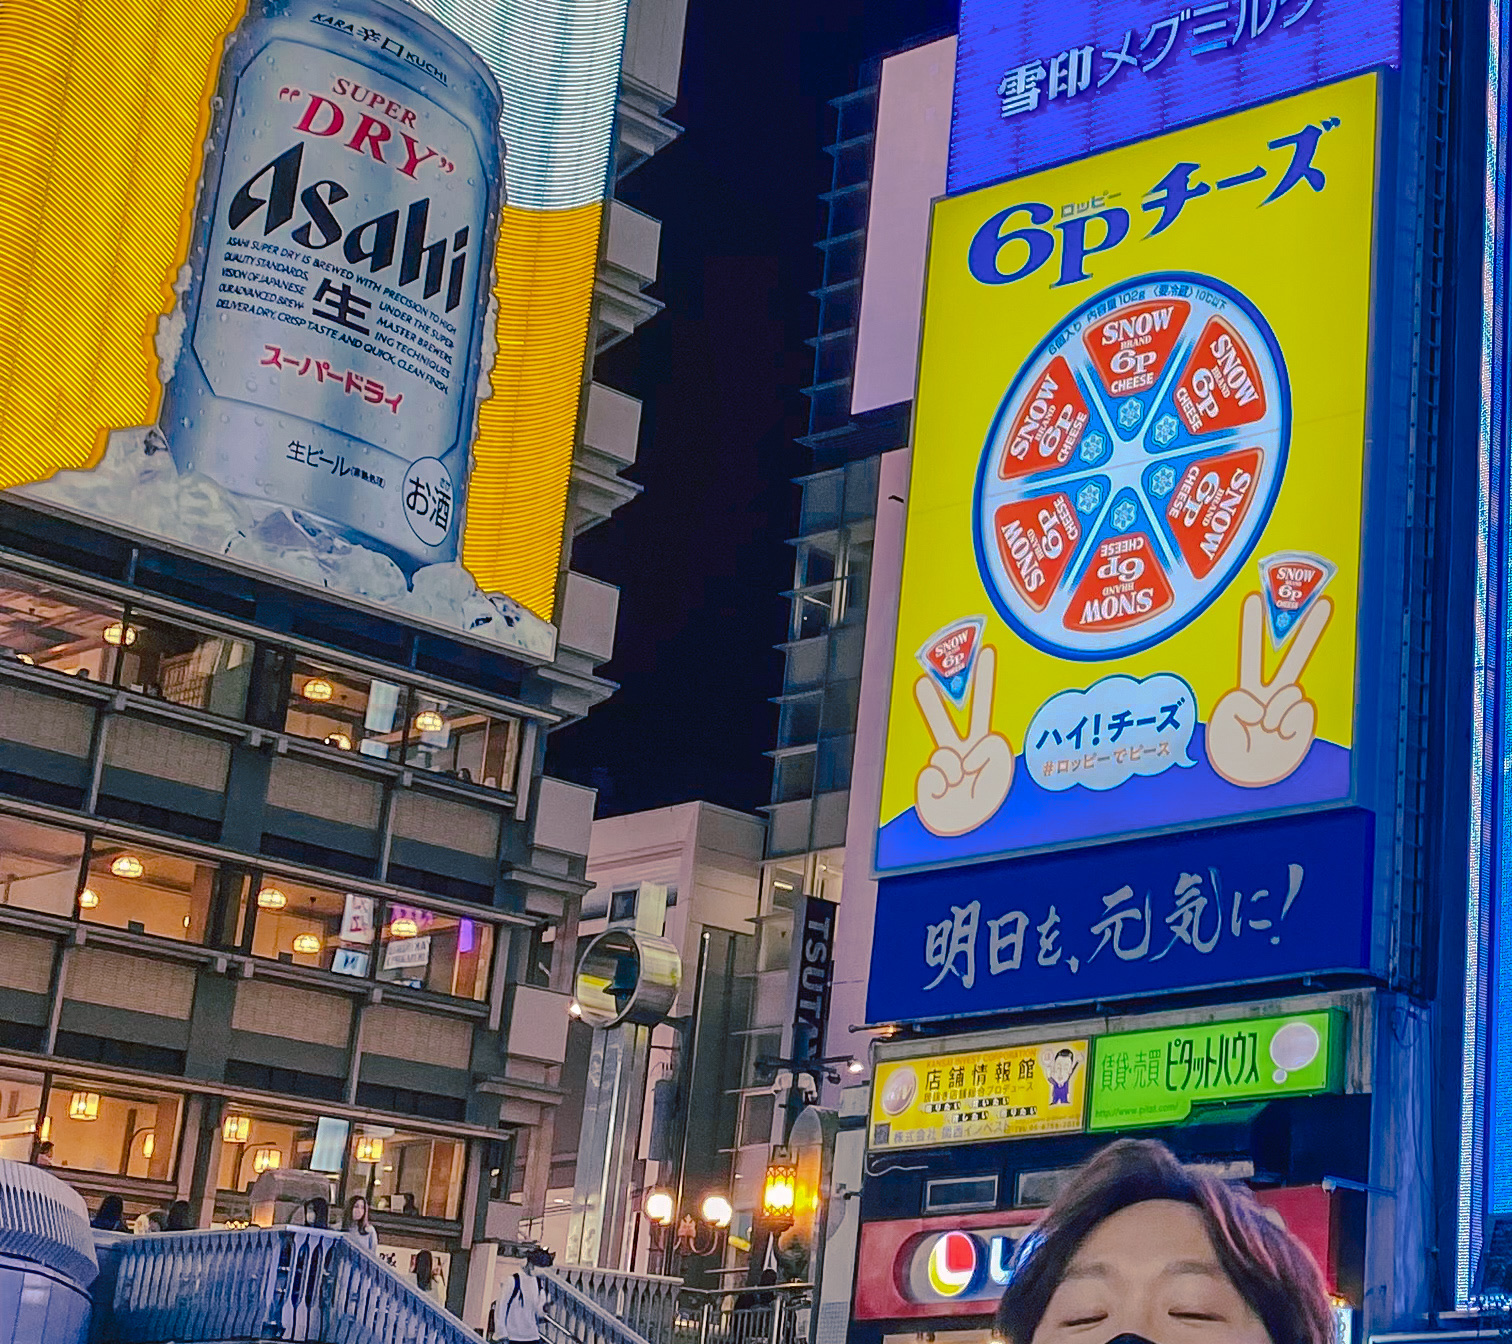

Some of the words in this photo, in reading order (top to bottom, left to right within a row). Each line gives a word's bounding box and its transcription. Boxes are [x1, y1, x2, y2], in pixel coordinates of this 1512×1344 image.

[312, 12, 355, 33] KARA
[356, 25, 405, 57] 辛口
[405, 51, 448, 83] KUCHI
[332, 78, 418, 130] SUPER
[227, 142, 469, 315] Asahi
[250, 240, 280, 255] SUPER
[280, 248, 301, 261] DRY
[312, 258, 354, 280] BREWED
[355, 274, 382, 293] WITH
[382, 287, 429, 317] PRECISION
[311, 277, 372, 337] 生
[376, 316, 417, 343] MASTER
[379, 300, 413, 324] UNDER
[414, 318, 431, 335] THE
[1101, 305, 1174, 346] SNOW
[306, 320, 340, 339] TASTE
[338, 333, 363, 349] AND
[260, 344, 403, 414] スーパードライ
[1109, 348, 1158, 376] 6P
[1110, 371, 1154, 394] CHEESE
[1210, 333, 1260, 407] SNOW
[1009, 372, 1059, 461] SNOW
[1175, 386, 1204, 432] CHEESE
[1191, 367, 1220, 419] 6P
[1038, 402, 1074, 458] 6P
[1056, 410, 1088, 463] CHEESE
[406, 476, 451, 533] お酒
[1168, 465, 1201, 519] CHEESE
[1183, 471, 1221, 528] 6P
[1199, 467, 1253, 561] SNOW
[1000, 519, 1046, 593] SNOW
[1096, 555, 1145, 583] 6P
[1100, 535, 1145, 556] CHEESE
[1276, 567, 1316, 583] SNOW
[1278, 584, 1303, 602] 6P
[1079, 587, 1154, 625] SNOW
[934, 629, 969, 658] SNOW
[925, 1058, 1035, 1092] 店舗情報館
[1165, 1031, 1260, 1092] ピタットハウス
